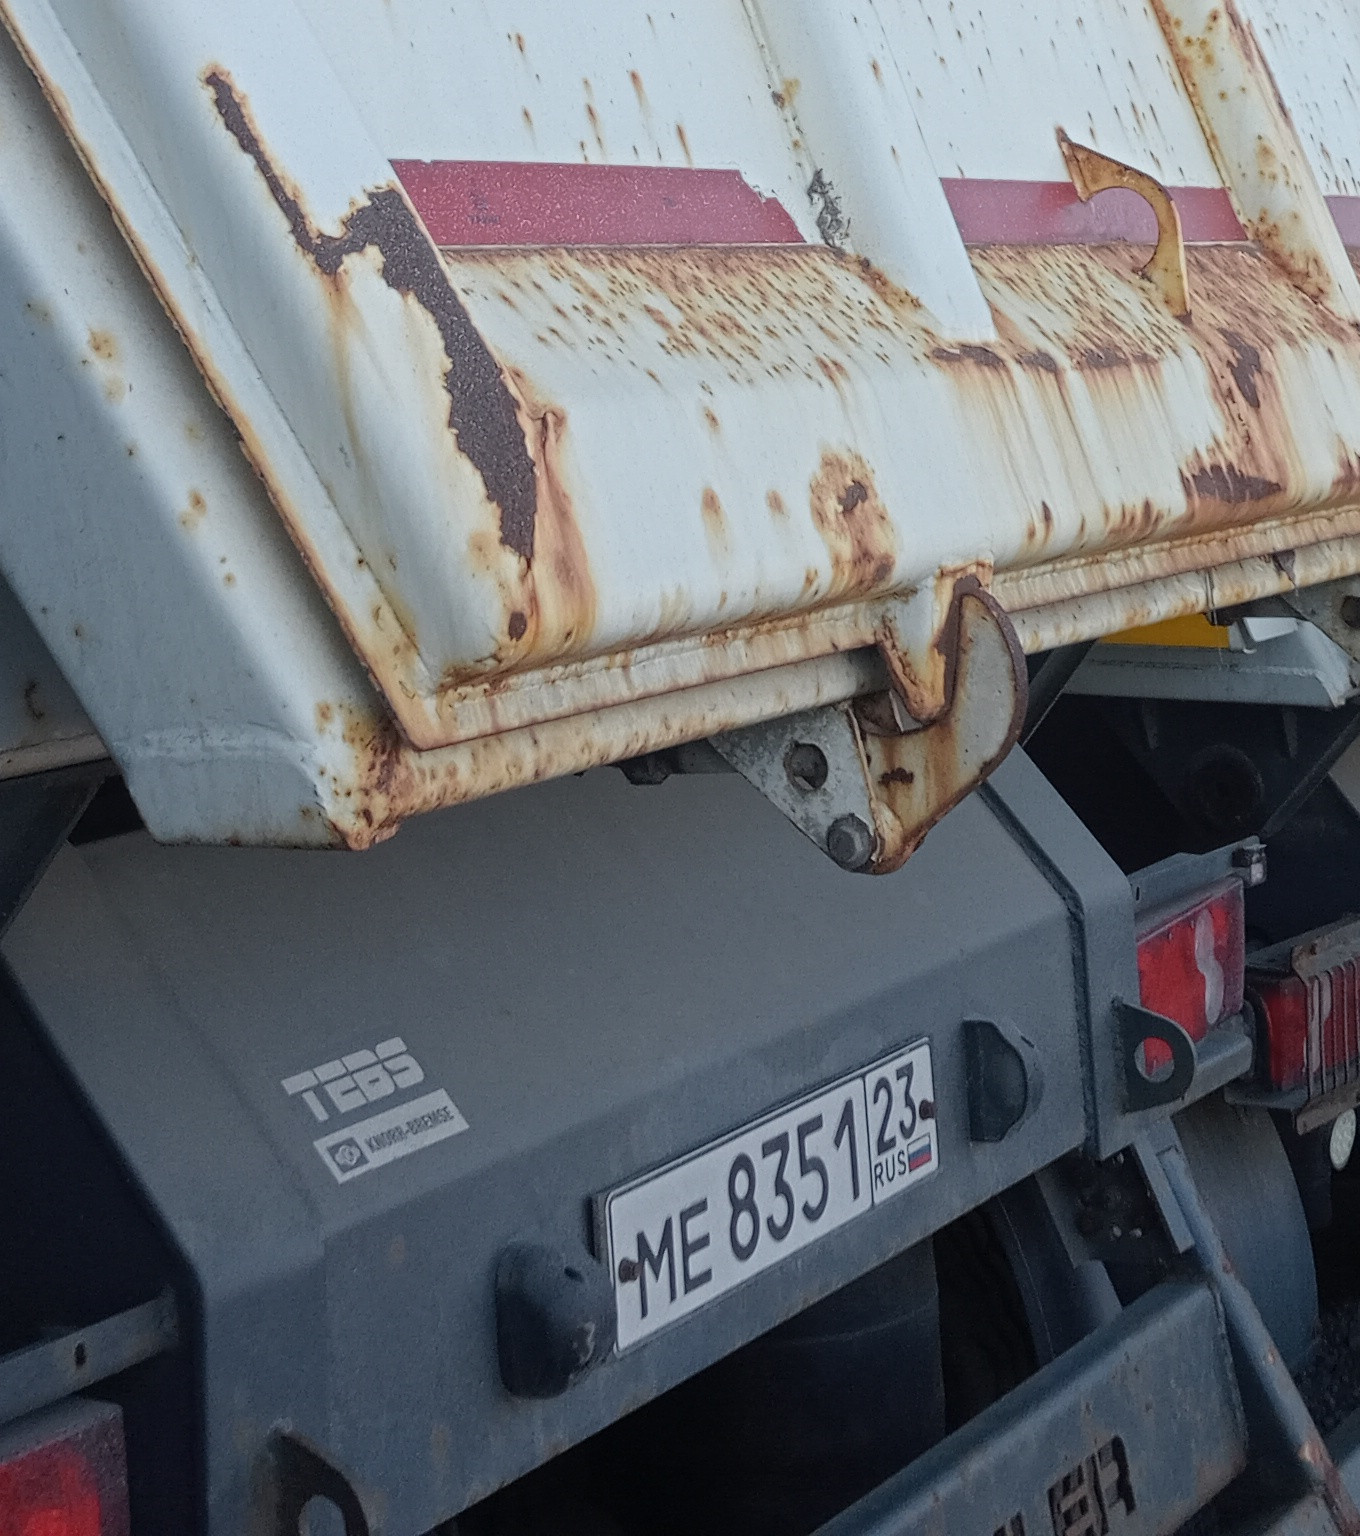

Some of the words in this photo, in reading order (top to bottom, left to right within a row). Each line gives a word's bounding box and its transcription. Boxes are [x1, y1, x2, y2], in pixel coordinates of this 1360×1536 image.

[281, 1037, 426, 1122] TEBS
[365, 1103, 455, 1156] KNORR-BREMSE
[636, 1200, 712, 1319] ME
[728, 1098, 865, 1263] 8351
[872, 1061, 918, 1157] 23
[873, 1150, 907, 1192] RUS
